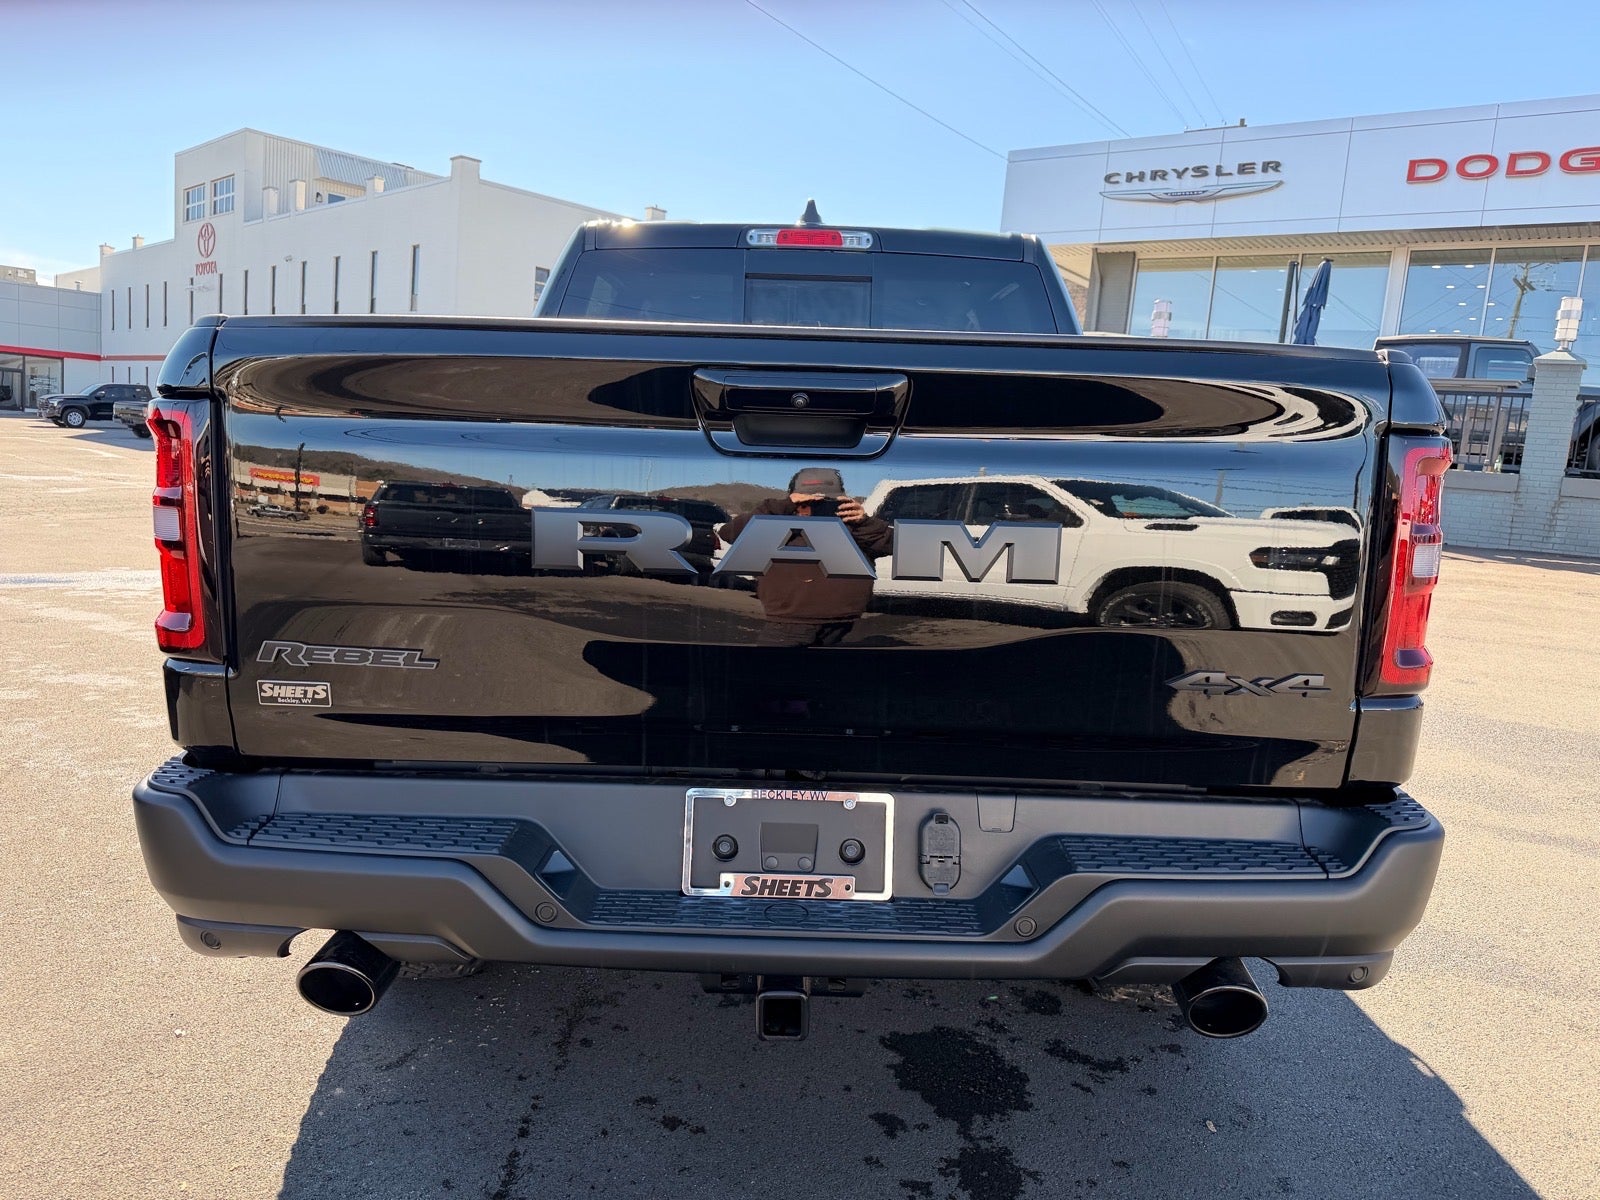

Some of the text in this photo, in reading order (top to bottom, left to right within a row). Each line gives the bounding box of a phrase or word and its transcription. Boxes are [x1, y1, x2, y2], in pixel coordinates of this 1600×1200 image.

[1104, 160, 1282, 185] CHRYSLER
[195, 261, 217, 276] TOYOTA
[531, 507, 1063, 584] RAM
[256, 640, 439, 669] REBEL
[261, 683, 327, 698] SHEETS
[741, 876, 834, 898] SHEETS
